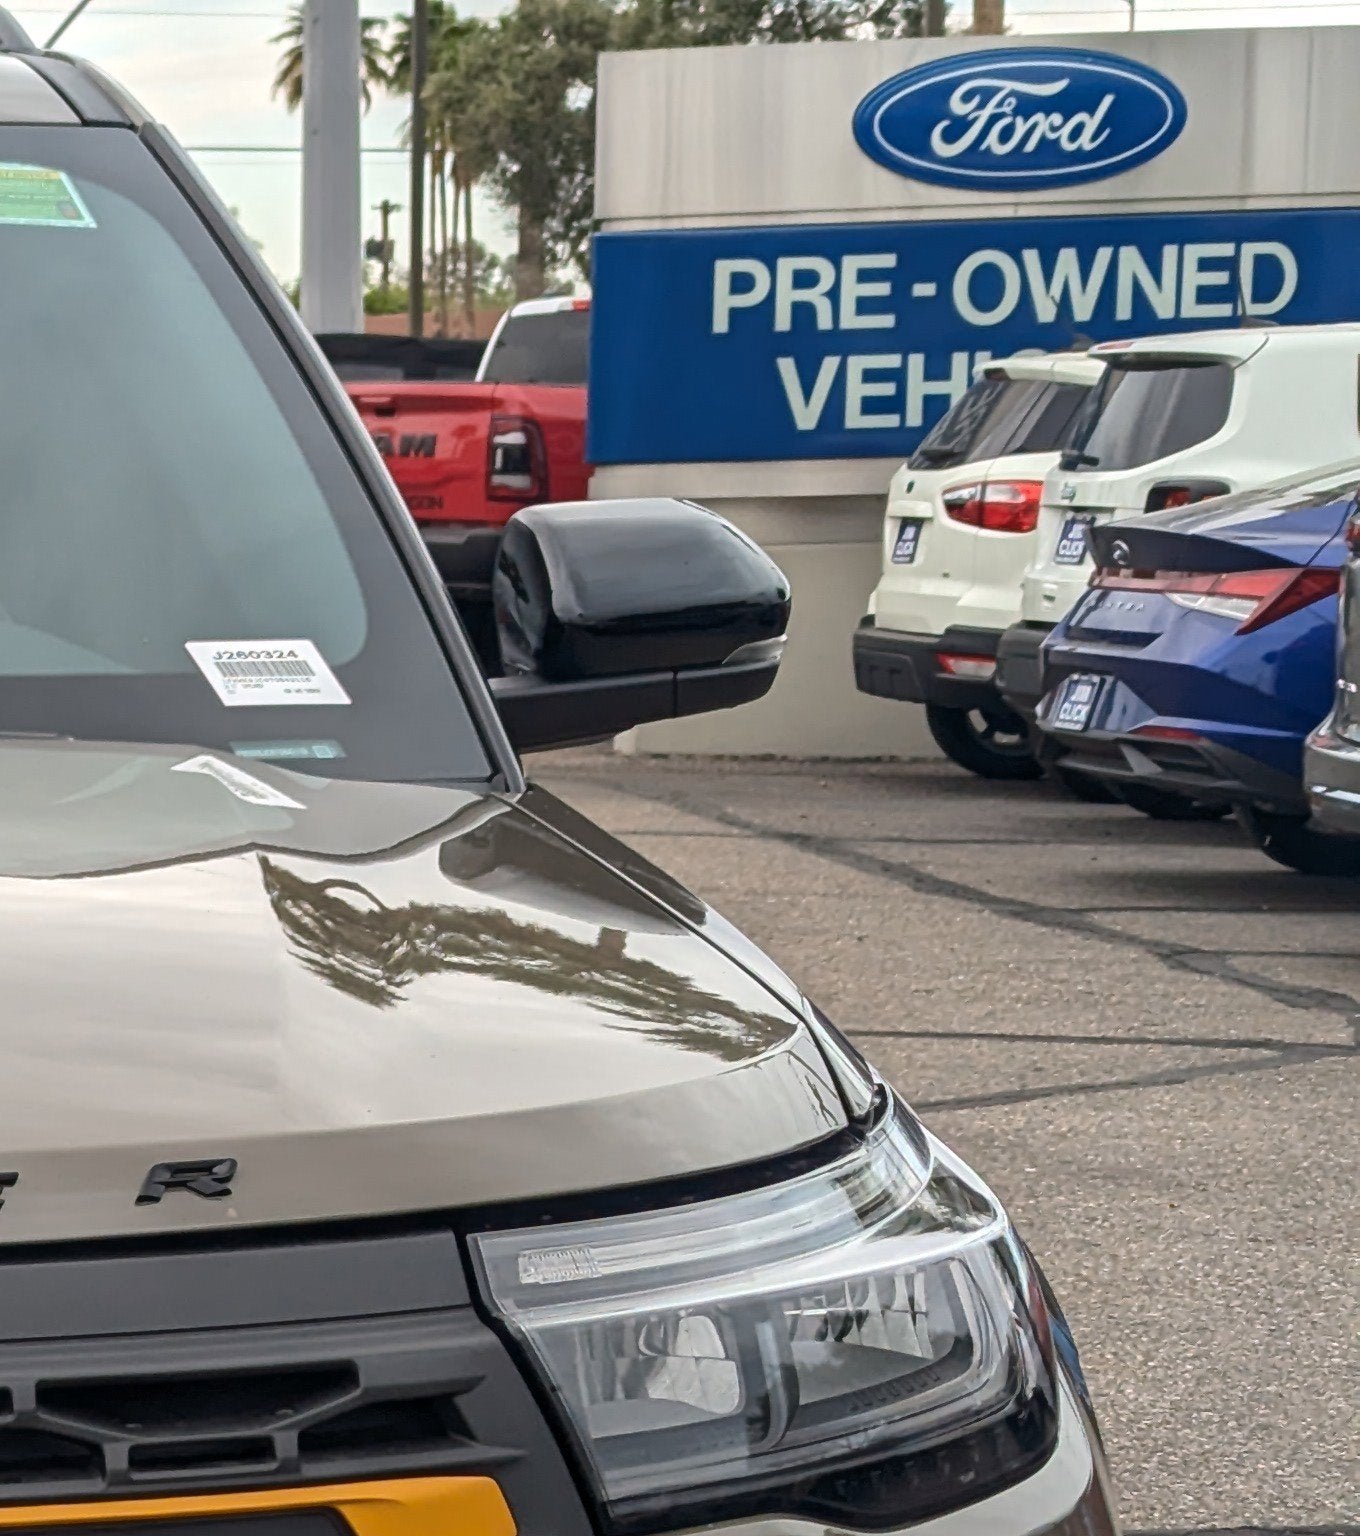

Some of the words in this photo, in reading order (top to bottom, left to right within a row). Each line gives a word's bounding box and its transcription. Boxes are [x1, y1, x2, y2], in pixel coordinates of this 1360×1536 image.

[929, 78, 1116, 158] Ford
[778, 348, 1047, 431] VEH
[374, 434, 437, 457] AM
